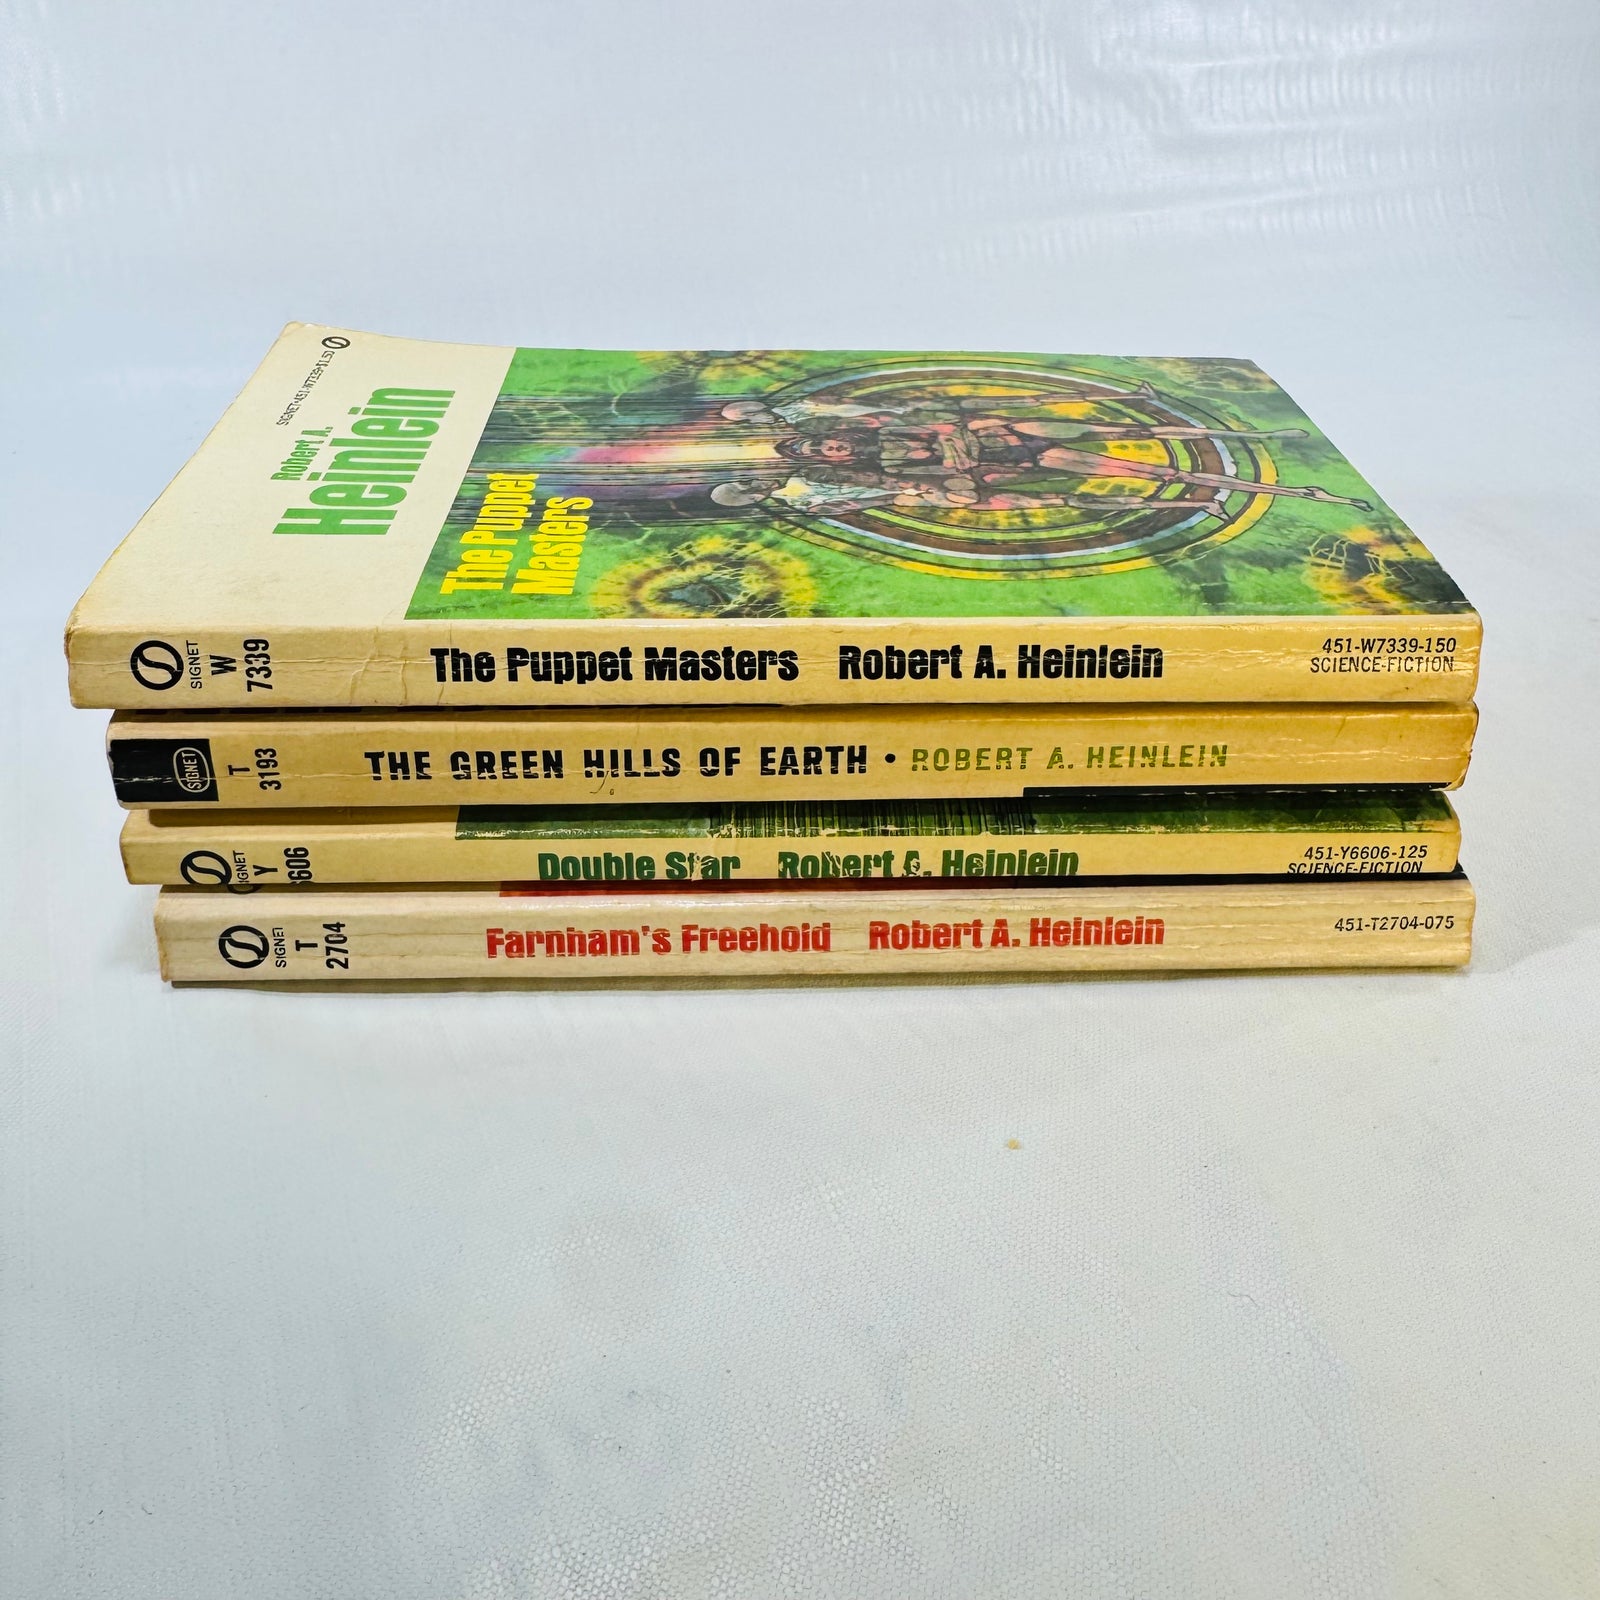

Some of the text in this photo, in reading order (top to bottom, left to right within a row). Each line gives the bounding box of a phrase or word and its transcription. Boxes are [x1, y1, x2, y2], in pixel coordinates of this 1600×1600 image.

[270, 426, 333, 481] Robert A.
[272, 387, 455, 536] Heinlein
[440, 473, 540, 595] The Puppet
[511, 496, 594, 595] Masters
[838, 643, 1164, 680] Robert A. Heinlein
[1322, 637, 1457, 654] 451-W7339-150
[185, 639, 203, 690] SIGNET
[209, 654, 237, 676] W
[242, 638, 273, 692] 7339
[429, 646, 800, 685] The Puppet Masters
[1310, 656, 1455, 673] SCIENCE-FICTION
[181, 751, 202, 789] SIGNET
[228, 764, 250, 776] T
[254, 748, 282, 790] 3193
[364, 745, 868, 781] THE GREEN HILLS OF EARTH
[911, 744, 1229, 772] ROBERT A. HEINLEIN
[232, 850, 249, 884] IGNET
[252, 864, 278, 877] Y
[283, 847, 315, 885] 606
[537, 851, 741, 880] Double Star
[778, 850, 894, 879] Robert
[942, 849, 1079, 877] Heinlein
[1287, 861, 1423, 874] SCIENCE-FICTION
[1304, 845, 1428, 860] 451-Y6606-125
[486, 922, 831, 959] Farnham's Freehold
[869, 916, 1164, 951] Robert A. Heinlein
[1334, 915, 1455, 931] 451-T2704-075
[272, 926, 287, 968] SIGNET
[295, 939, 318, 952] T
[322, 921, 349, 970] 2704
